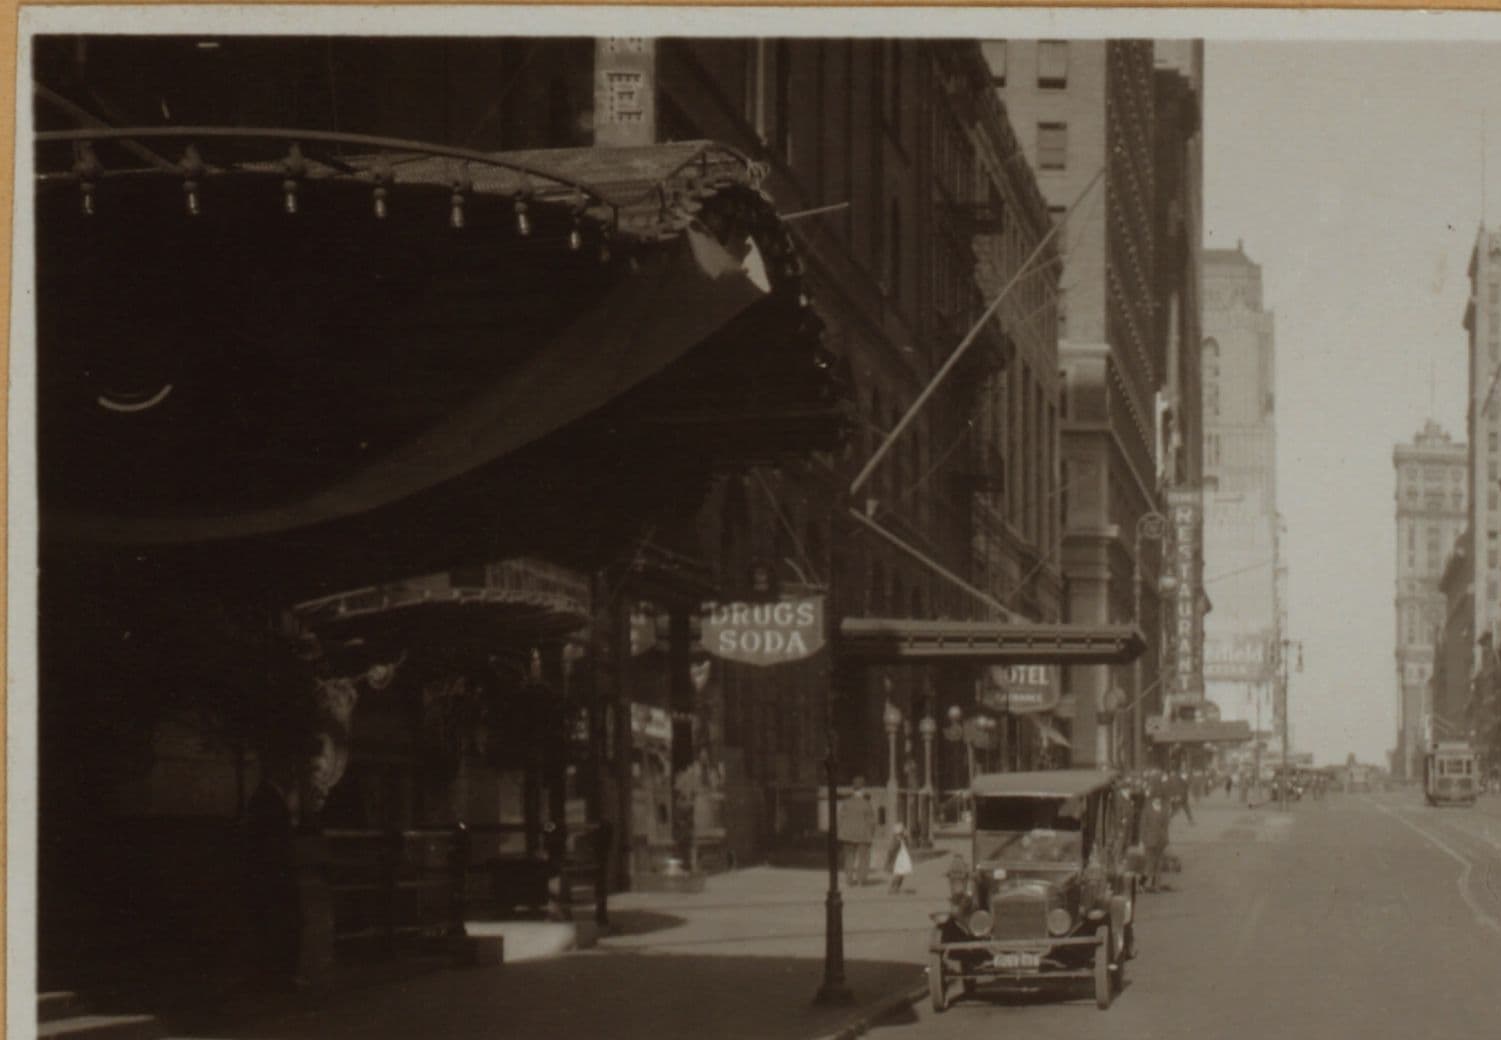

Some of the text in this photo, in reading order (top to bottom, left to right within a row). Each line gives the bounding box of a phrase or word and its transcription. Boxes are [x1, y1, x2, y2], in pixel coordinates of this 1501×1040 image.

[1175, 506, 1193, 690] RESTAURANT
[701, 602, 815, 625] DRUGS
[719, 630, 807, 654] SODA
[994, 664, 1050, 685] OTEL
